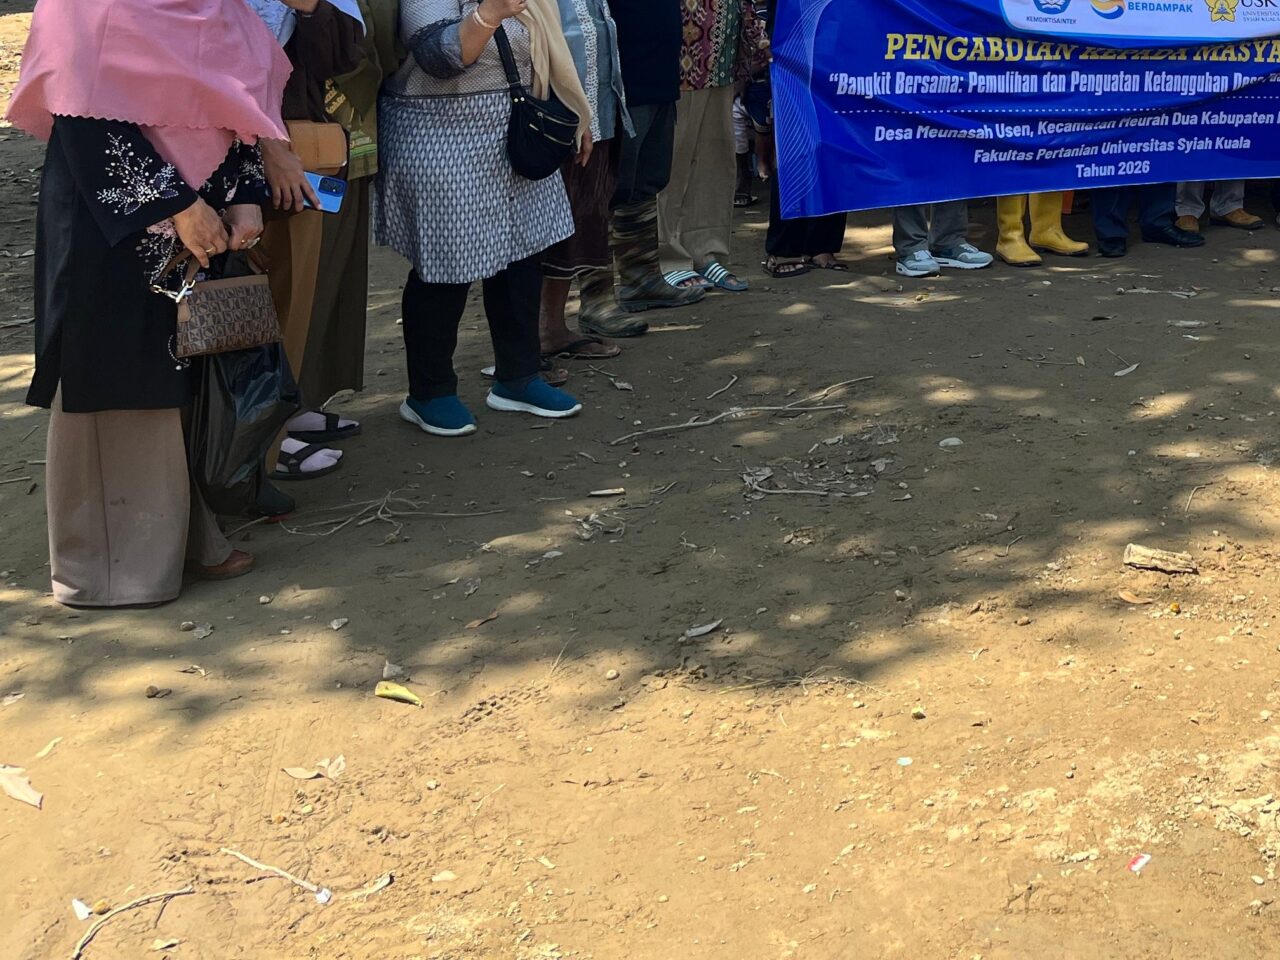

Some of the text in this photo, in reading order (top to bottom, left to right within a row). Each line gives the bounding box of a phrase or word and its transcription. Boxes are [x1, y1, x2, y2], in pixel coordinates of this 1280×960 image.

[1128, 1, 1193, 13] BERDAMPAK
[884, 34, 1079, 62] PENGABDIAN
[829, 71, 891, 99] “Bangkit
[895, 70, 964, 94] Bersama:
[968, 70, 1038, 94] Pemulihan
[1042, 71, 1066, 93] dan
[1070, 70, 1140, 96] Penguatan
[1144, 70, 1229, 96] Ketangguhan
[874, 126, 912, 142] Desa
[916, 124, 994, 140] Meunasah
[996, 121, 1034, 138] Usen,
[1172, 112, 1198, 126] Dua
[1200, 110, 1274, 127] Kabupaten
[974, 136, 1251, 163] Fakultas Pertanian Universitas Syiah Kuala
[1076, 160, 1150, 178] Tahun 2026
